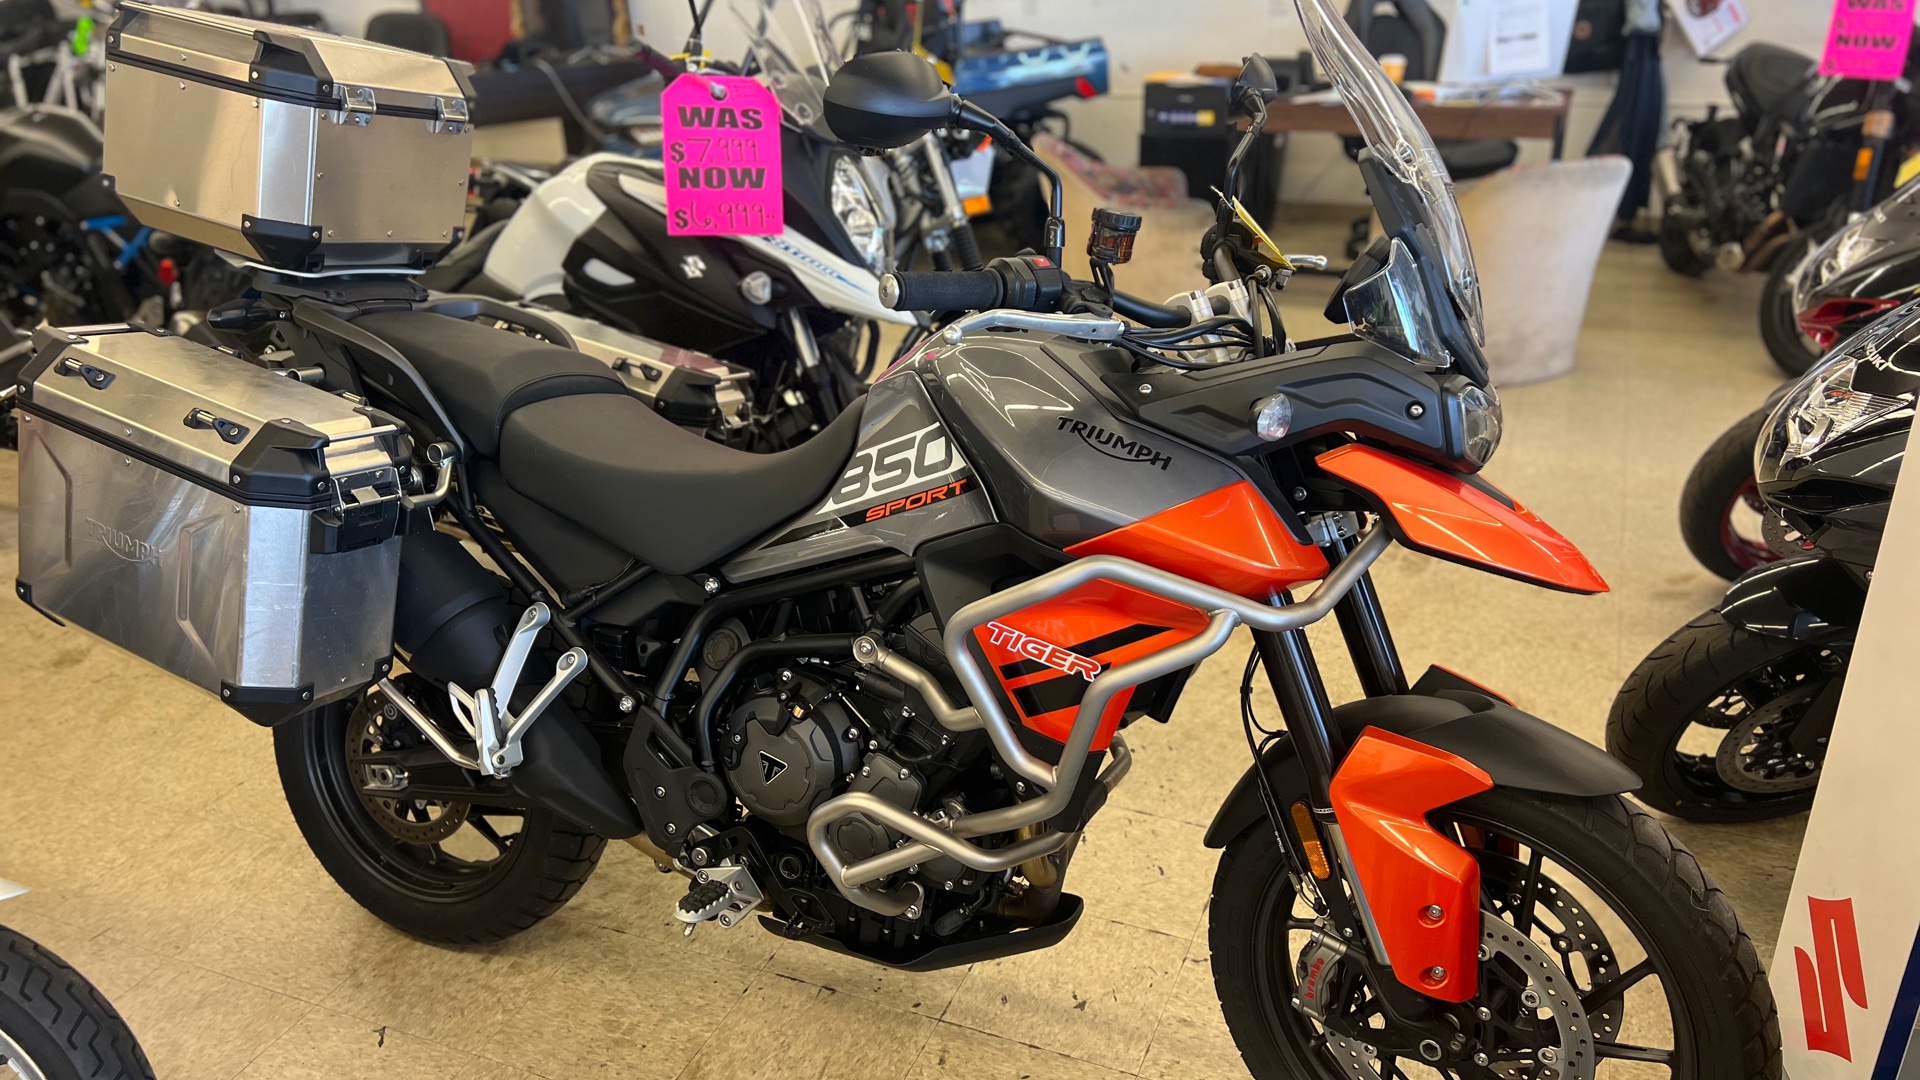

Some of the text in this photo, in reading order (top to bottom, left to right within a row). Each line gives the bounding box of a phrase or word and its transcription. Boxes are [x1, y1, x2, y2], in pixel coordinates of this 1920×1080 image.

[1836, 34, 1897, 49] NOW
[677, 106, 763, 130] WAS
[678, 167, 766, 189] NOW
[832, 423, 953, 505] 850
[1057, 416, 1172, 471] TRIUMPH
[865, 478, 968, 522] SPORT
[85, 516, 162, 568] TRIUMPH
[987, 621, 1101, 682] TIGER
[1305, 957, 1325, 1001] brembo
